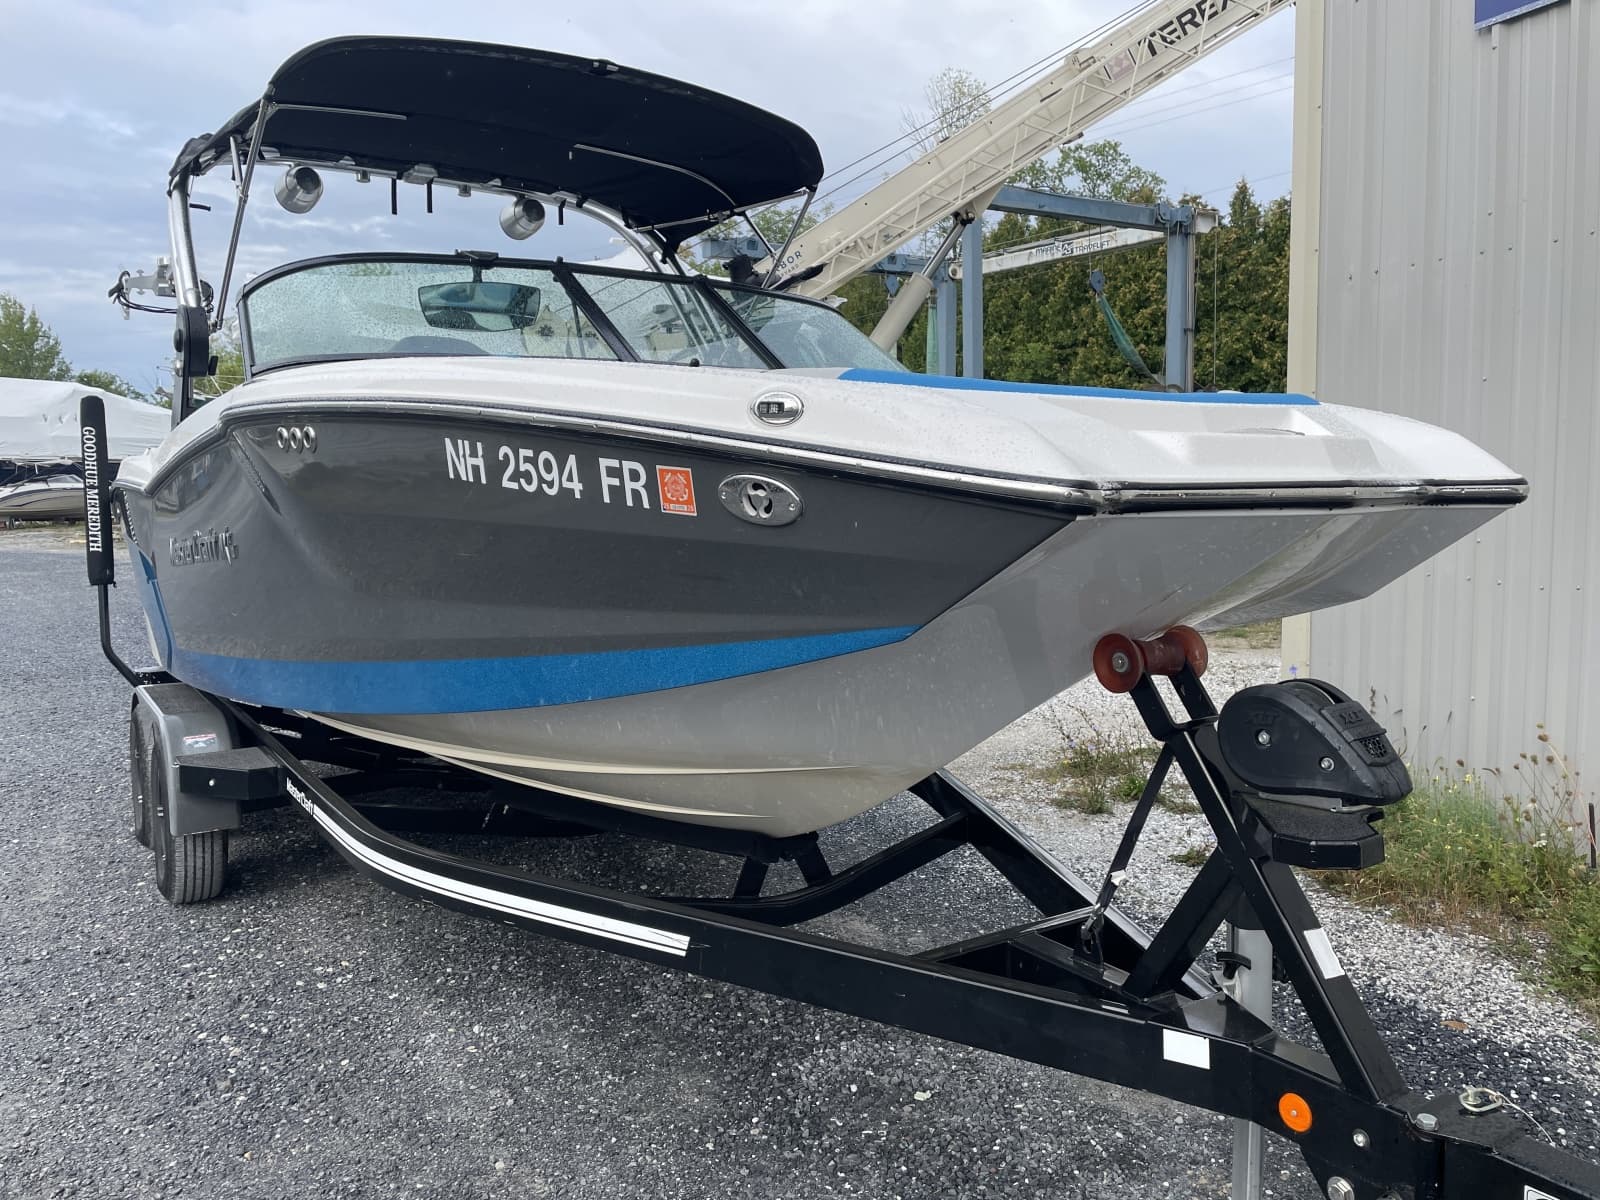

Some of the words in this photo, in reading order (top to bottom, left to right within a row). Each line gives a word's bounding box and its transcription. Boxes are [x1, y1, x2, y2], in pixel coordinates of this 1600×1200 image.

[83, 426, 98, 487] GOODHUE
[445, 437, 487, 484] NH
[499, 445, 583, 499] 2594
[599, 457, 650, 509] FR
[87, 488, 102, 552] MEREDITH
